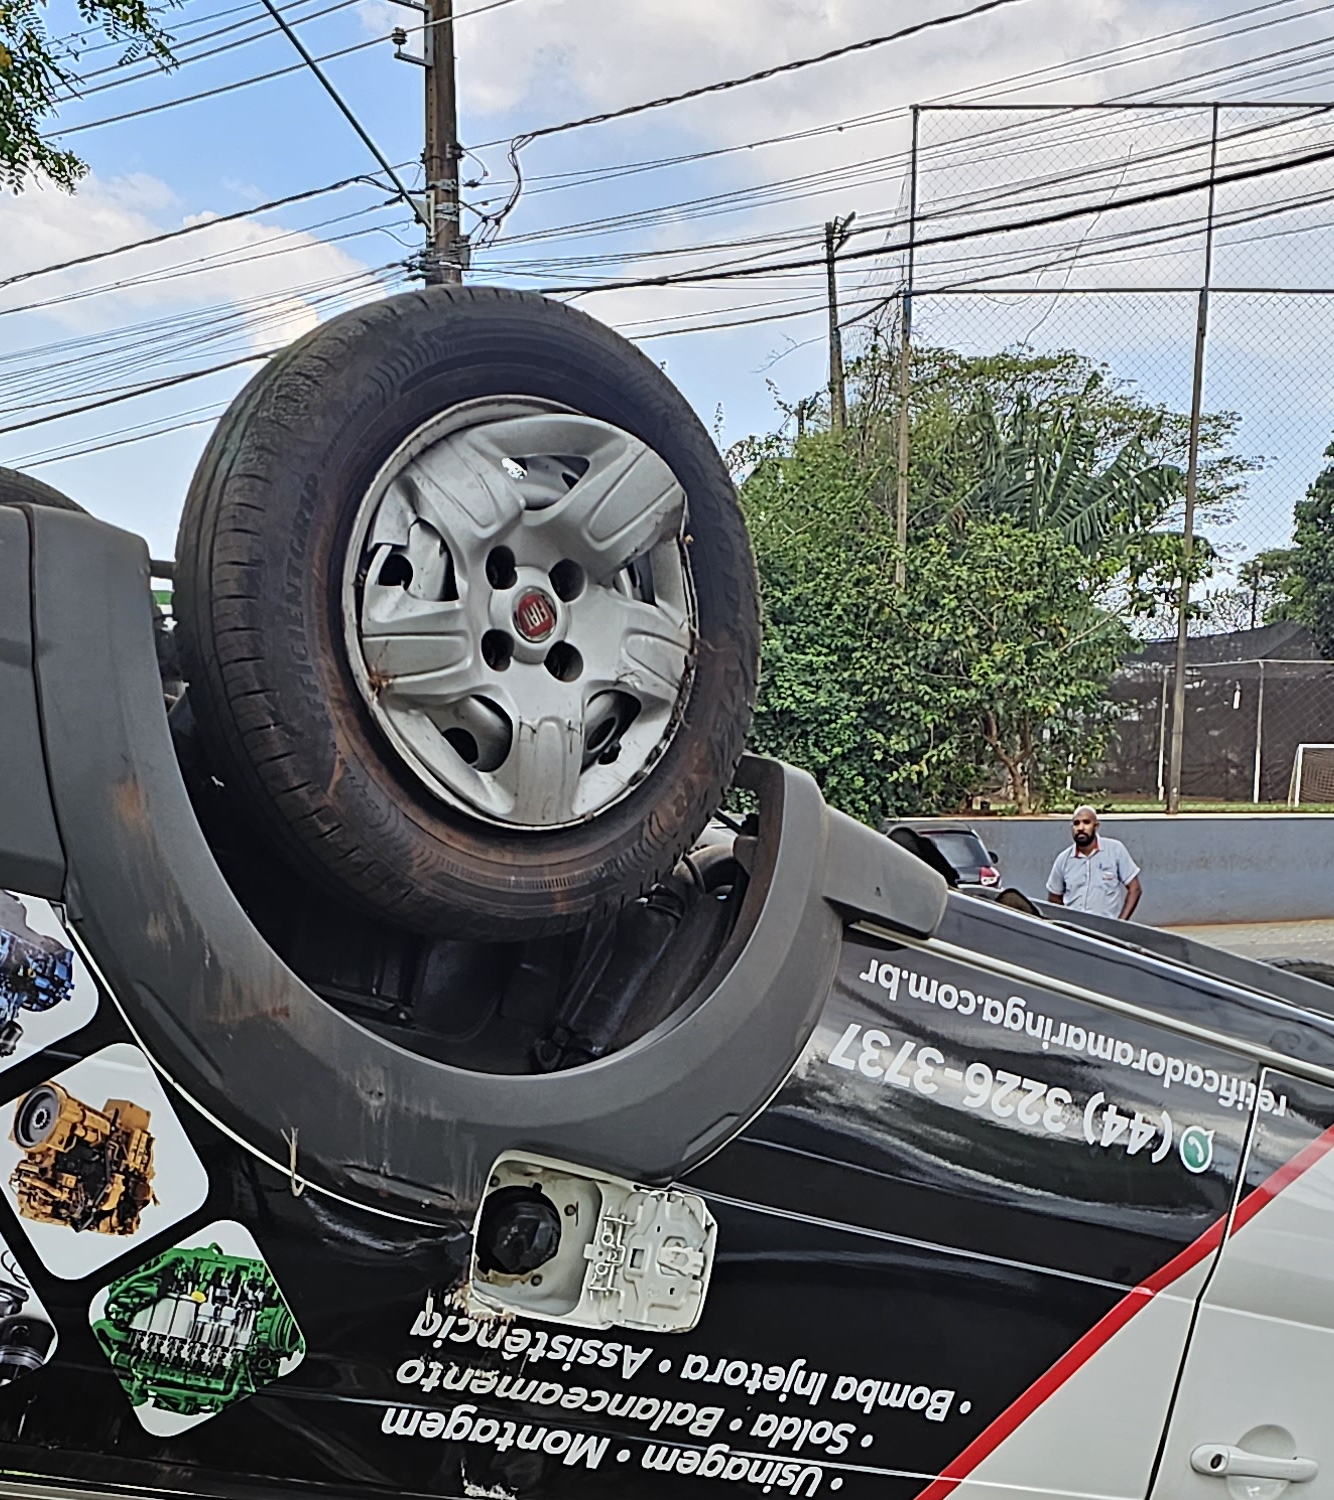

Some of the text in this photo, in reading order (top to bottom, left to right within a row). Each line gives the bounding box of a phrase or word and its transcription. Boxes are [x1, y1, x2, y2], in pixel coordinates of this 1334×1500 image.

[522, 600, 549, 629] FIAT
[860, 958, 1287, 1119] retificadoramaringa.com.br
[827, 1023, 1173, 1163] (44) 3226-3737
[396, 1358, 857, 1454] Solda Balanceamento
[409, 1311, 955, 1421] Bomba Injetora Assistência
[380, 1405, 823, 1498] Usinagem Montagem
